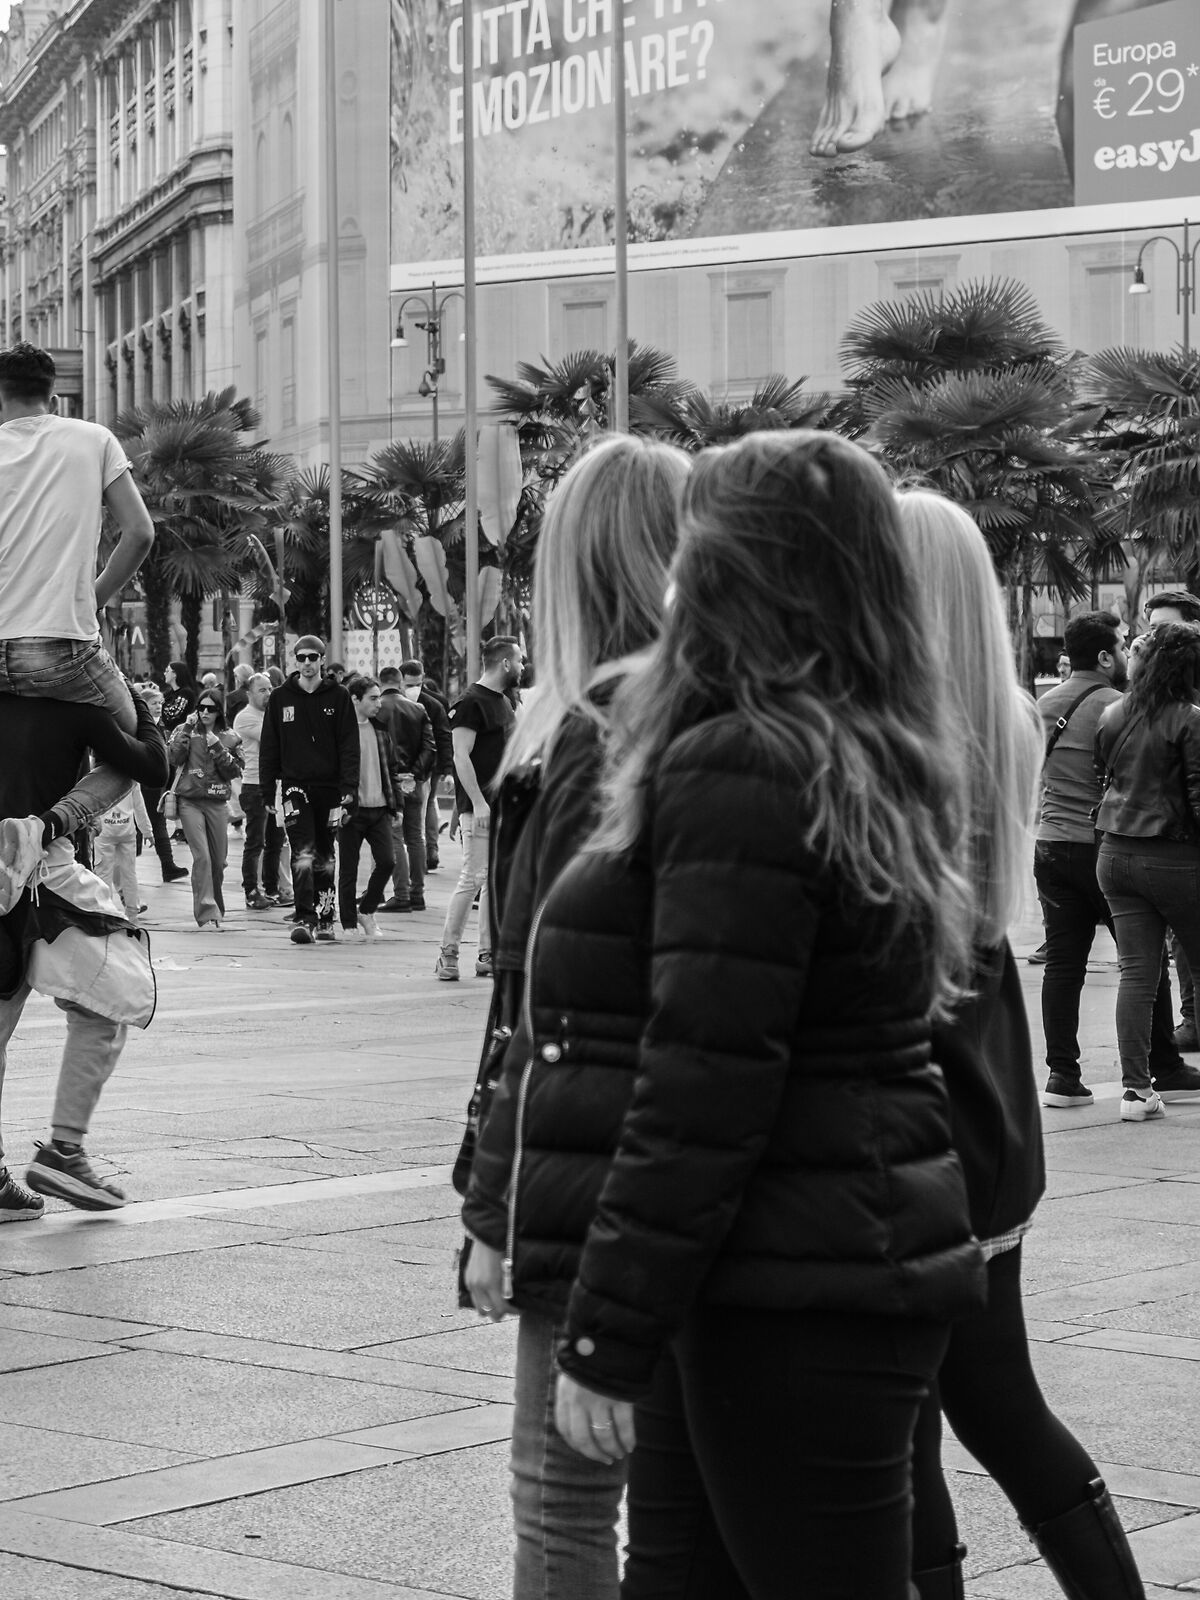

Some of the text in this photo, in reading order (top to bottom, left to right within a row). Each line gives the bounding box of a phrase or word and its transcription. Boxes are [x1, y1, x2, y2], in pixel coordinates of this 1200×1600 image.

[1093, 40, 1177, 67] Europa
[449, 20, 715, 145] EMOZIONARE?
[1093, 76, 1107, 88] da
[1093, 87, 1118, 119] €
